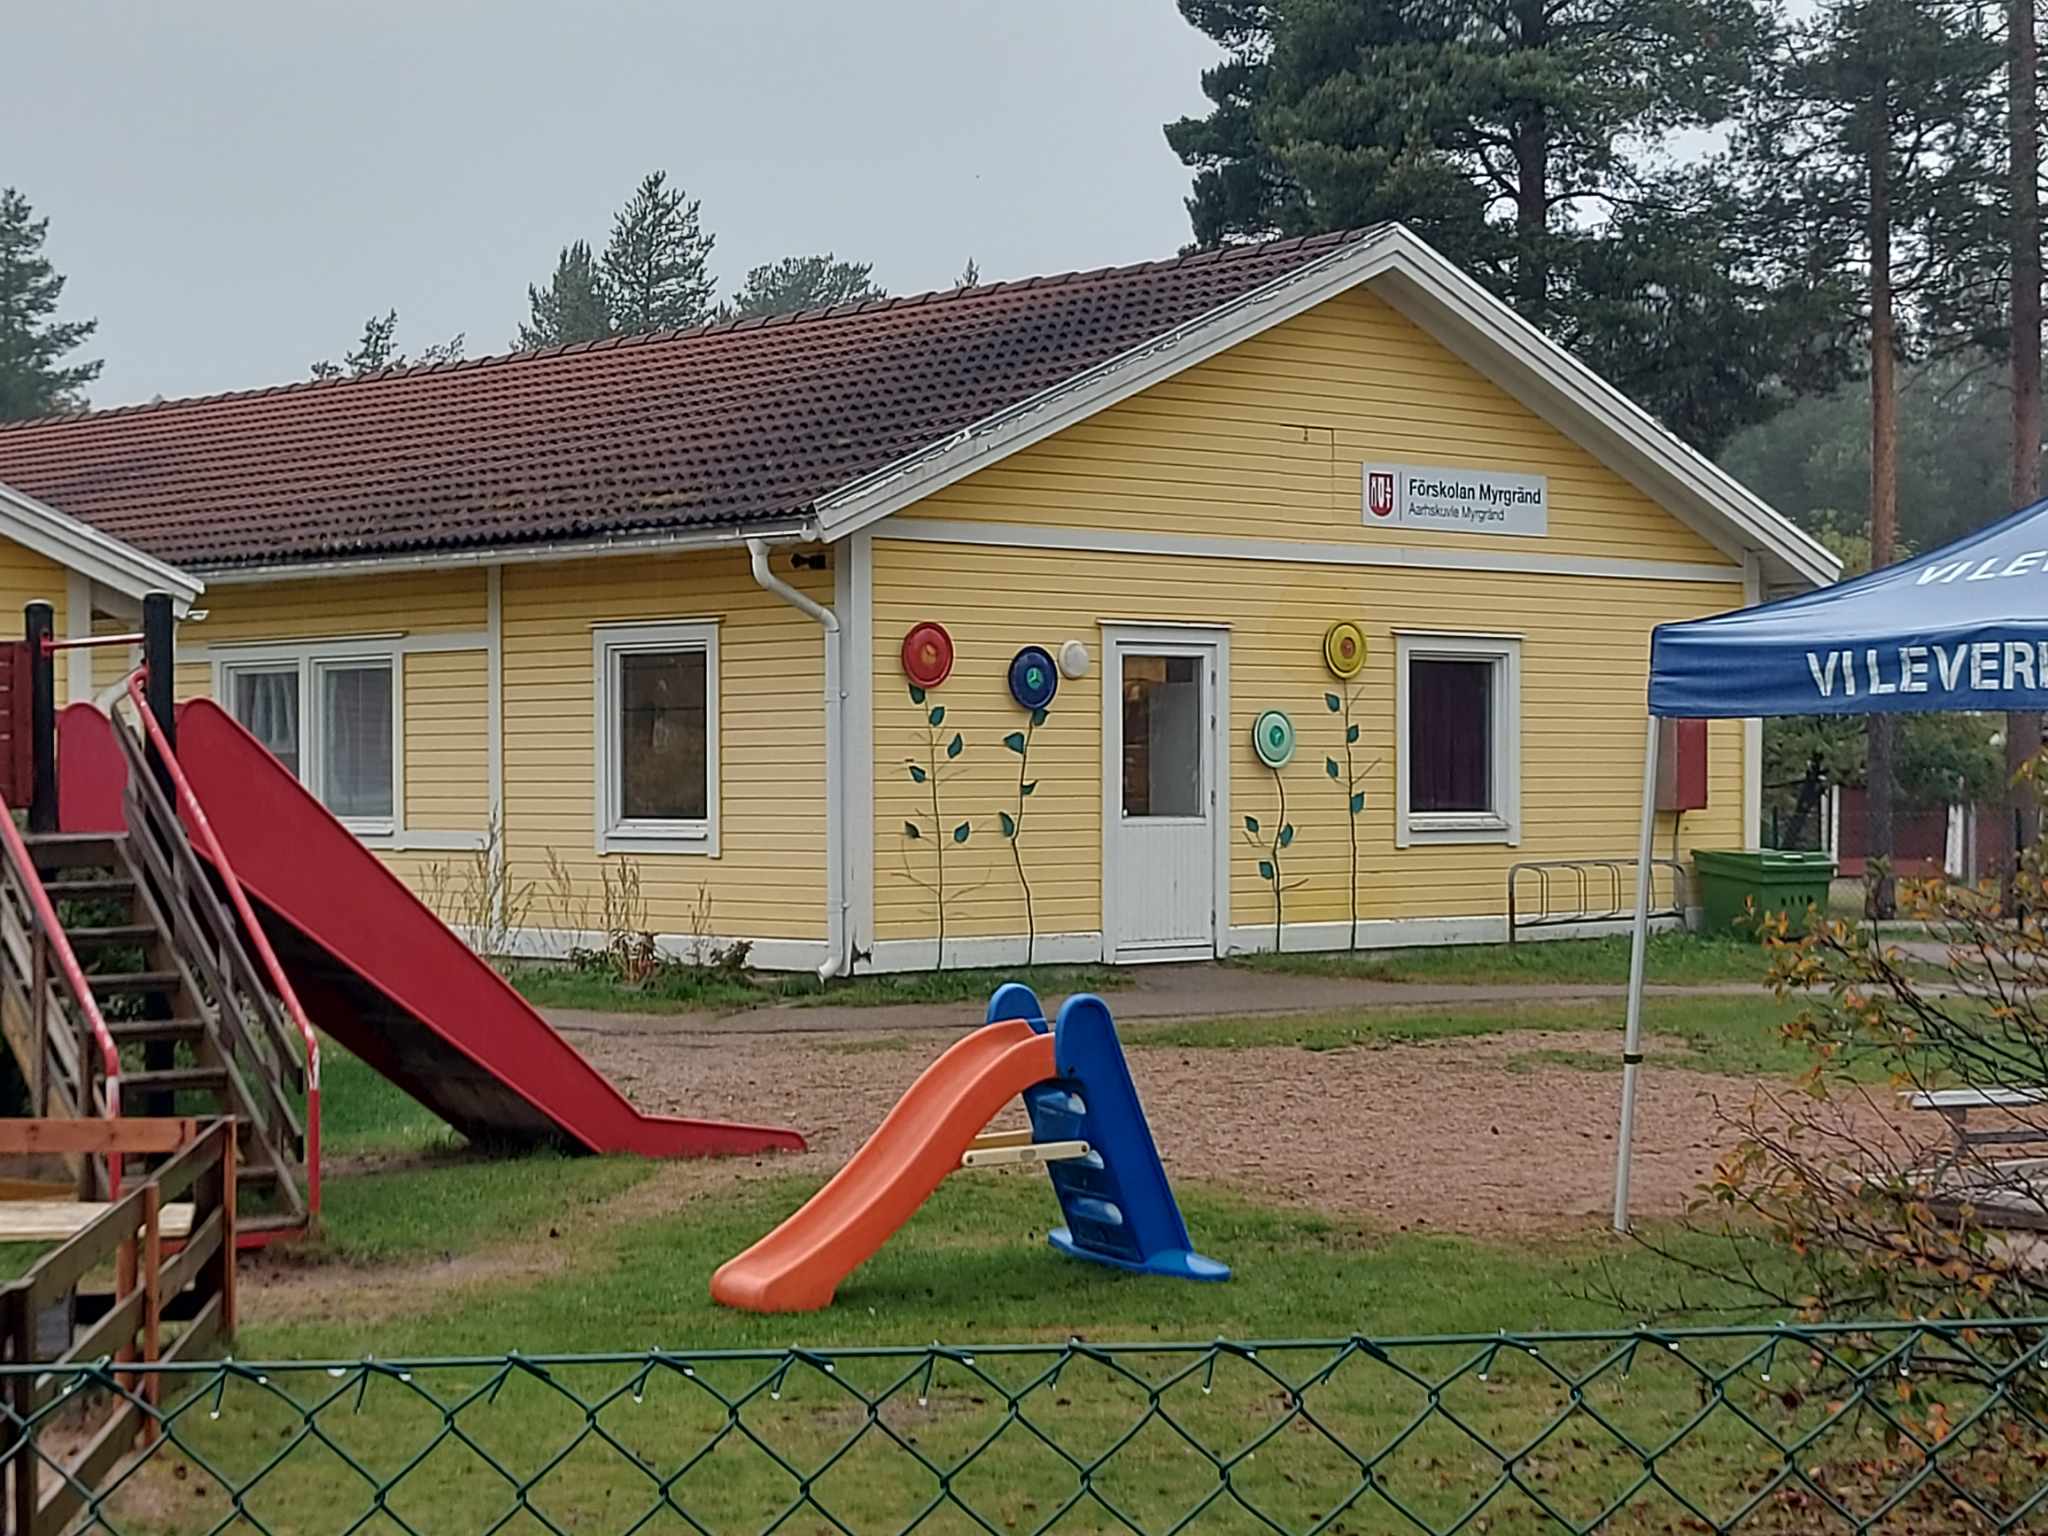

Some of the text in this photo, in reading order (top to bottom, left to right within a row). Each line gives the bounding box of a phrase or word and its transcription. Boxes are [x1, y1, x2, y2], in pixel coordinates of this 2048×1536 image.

[1409, 479, 1541, 506] Förskolan Myrgränd
[1915, 551, 2048, 585] VILE
